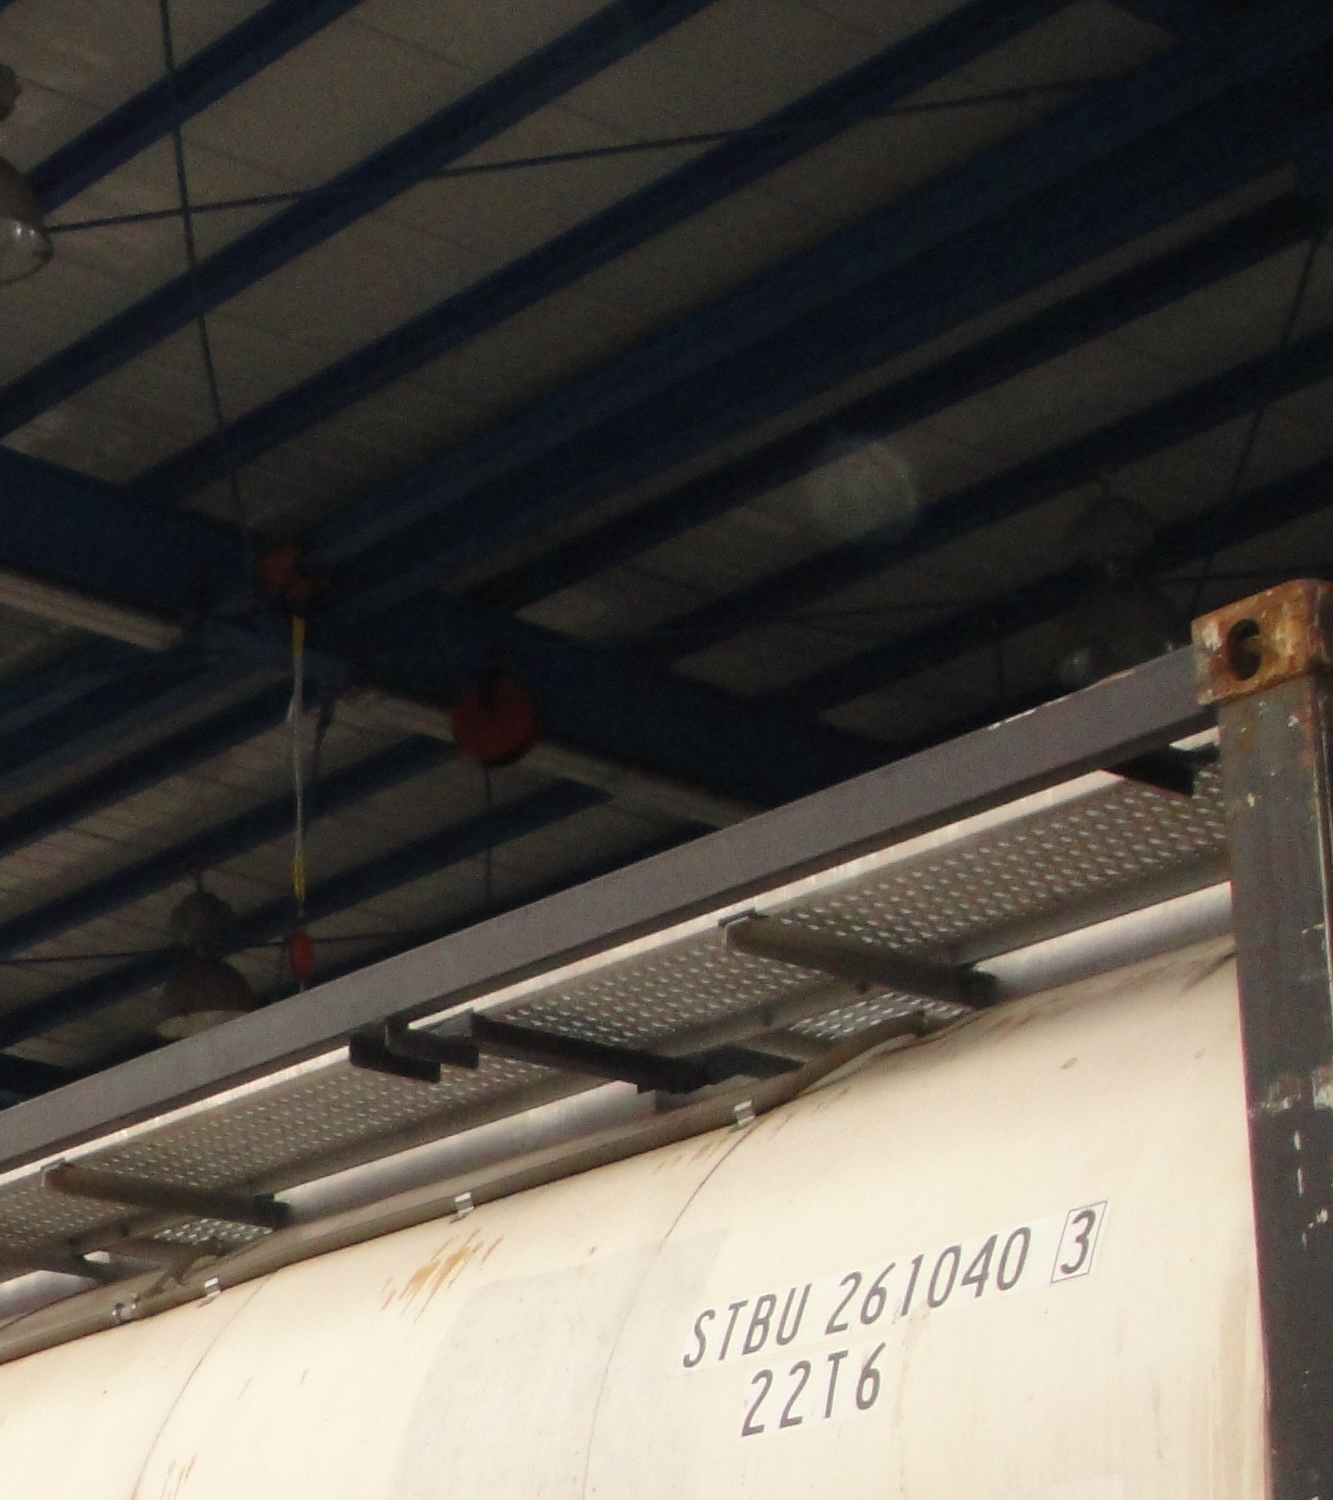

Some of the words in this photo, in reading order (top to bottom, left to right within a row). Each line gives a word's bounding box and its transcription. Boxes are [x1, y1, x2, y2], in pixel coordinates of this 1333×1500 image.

[682, 1283, 812, 1368] STBU
[824, 1227, 1032, 1335] 261040
[1059, 1209, 1097, 1275] 3
[741, 1342, 887, 1437] 22T6
